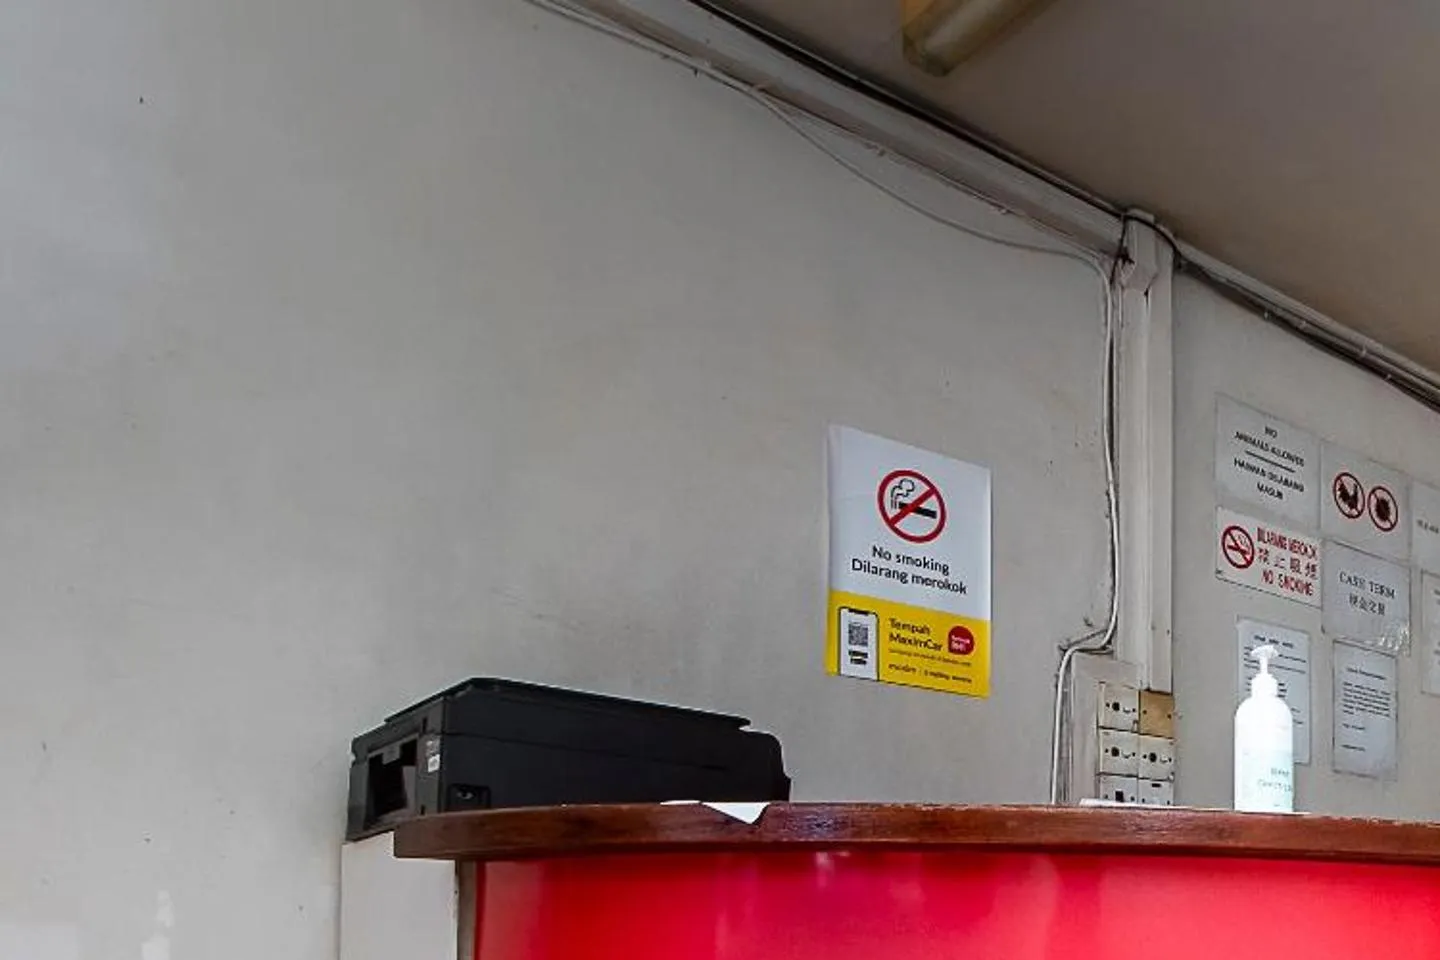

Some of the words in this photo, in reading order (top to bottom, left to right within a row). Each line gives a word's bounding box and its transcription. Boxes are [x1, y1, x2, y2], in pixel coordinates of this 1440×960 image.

[872, 545, 892, 561] No
[895, 553, 950, 577] smoking
[851, 558, 909, 585] Dilarang
[911, 573, 967, 595] merokok
[1262, 570, 1274, 585] NO
[1278, 573, 1314, 597] SMOKING
[889, 617, 931, 635] Tempah
[889, 632, 943, 651] MaximCar
